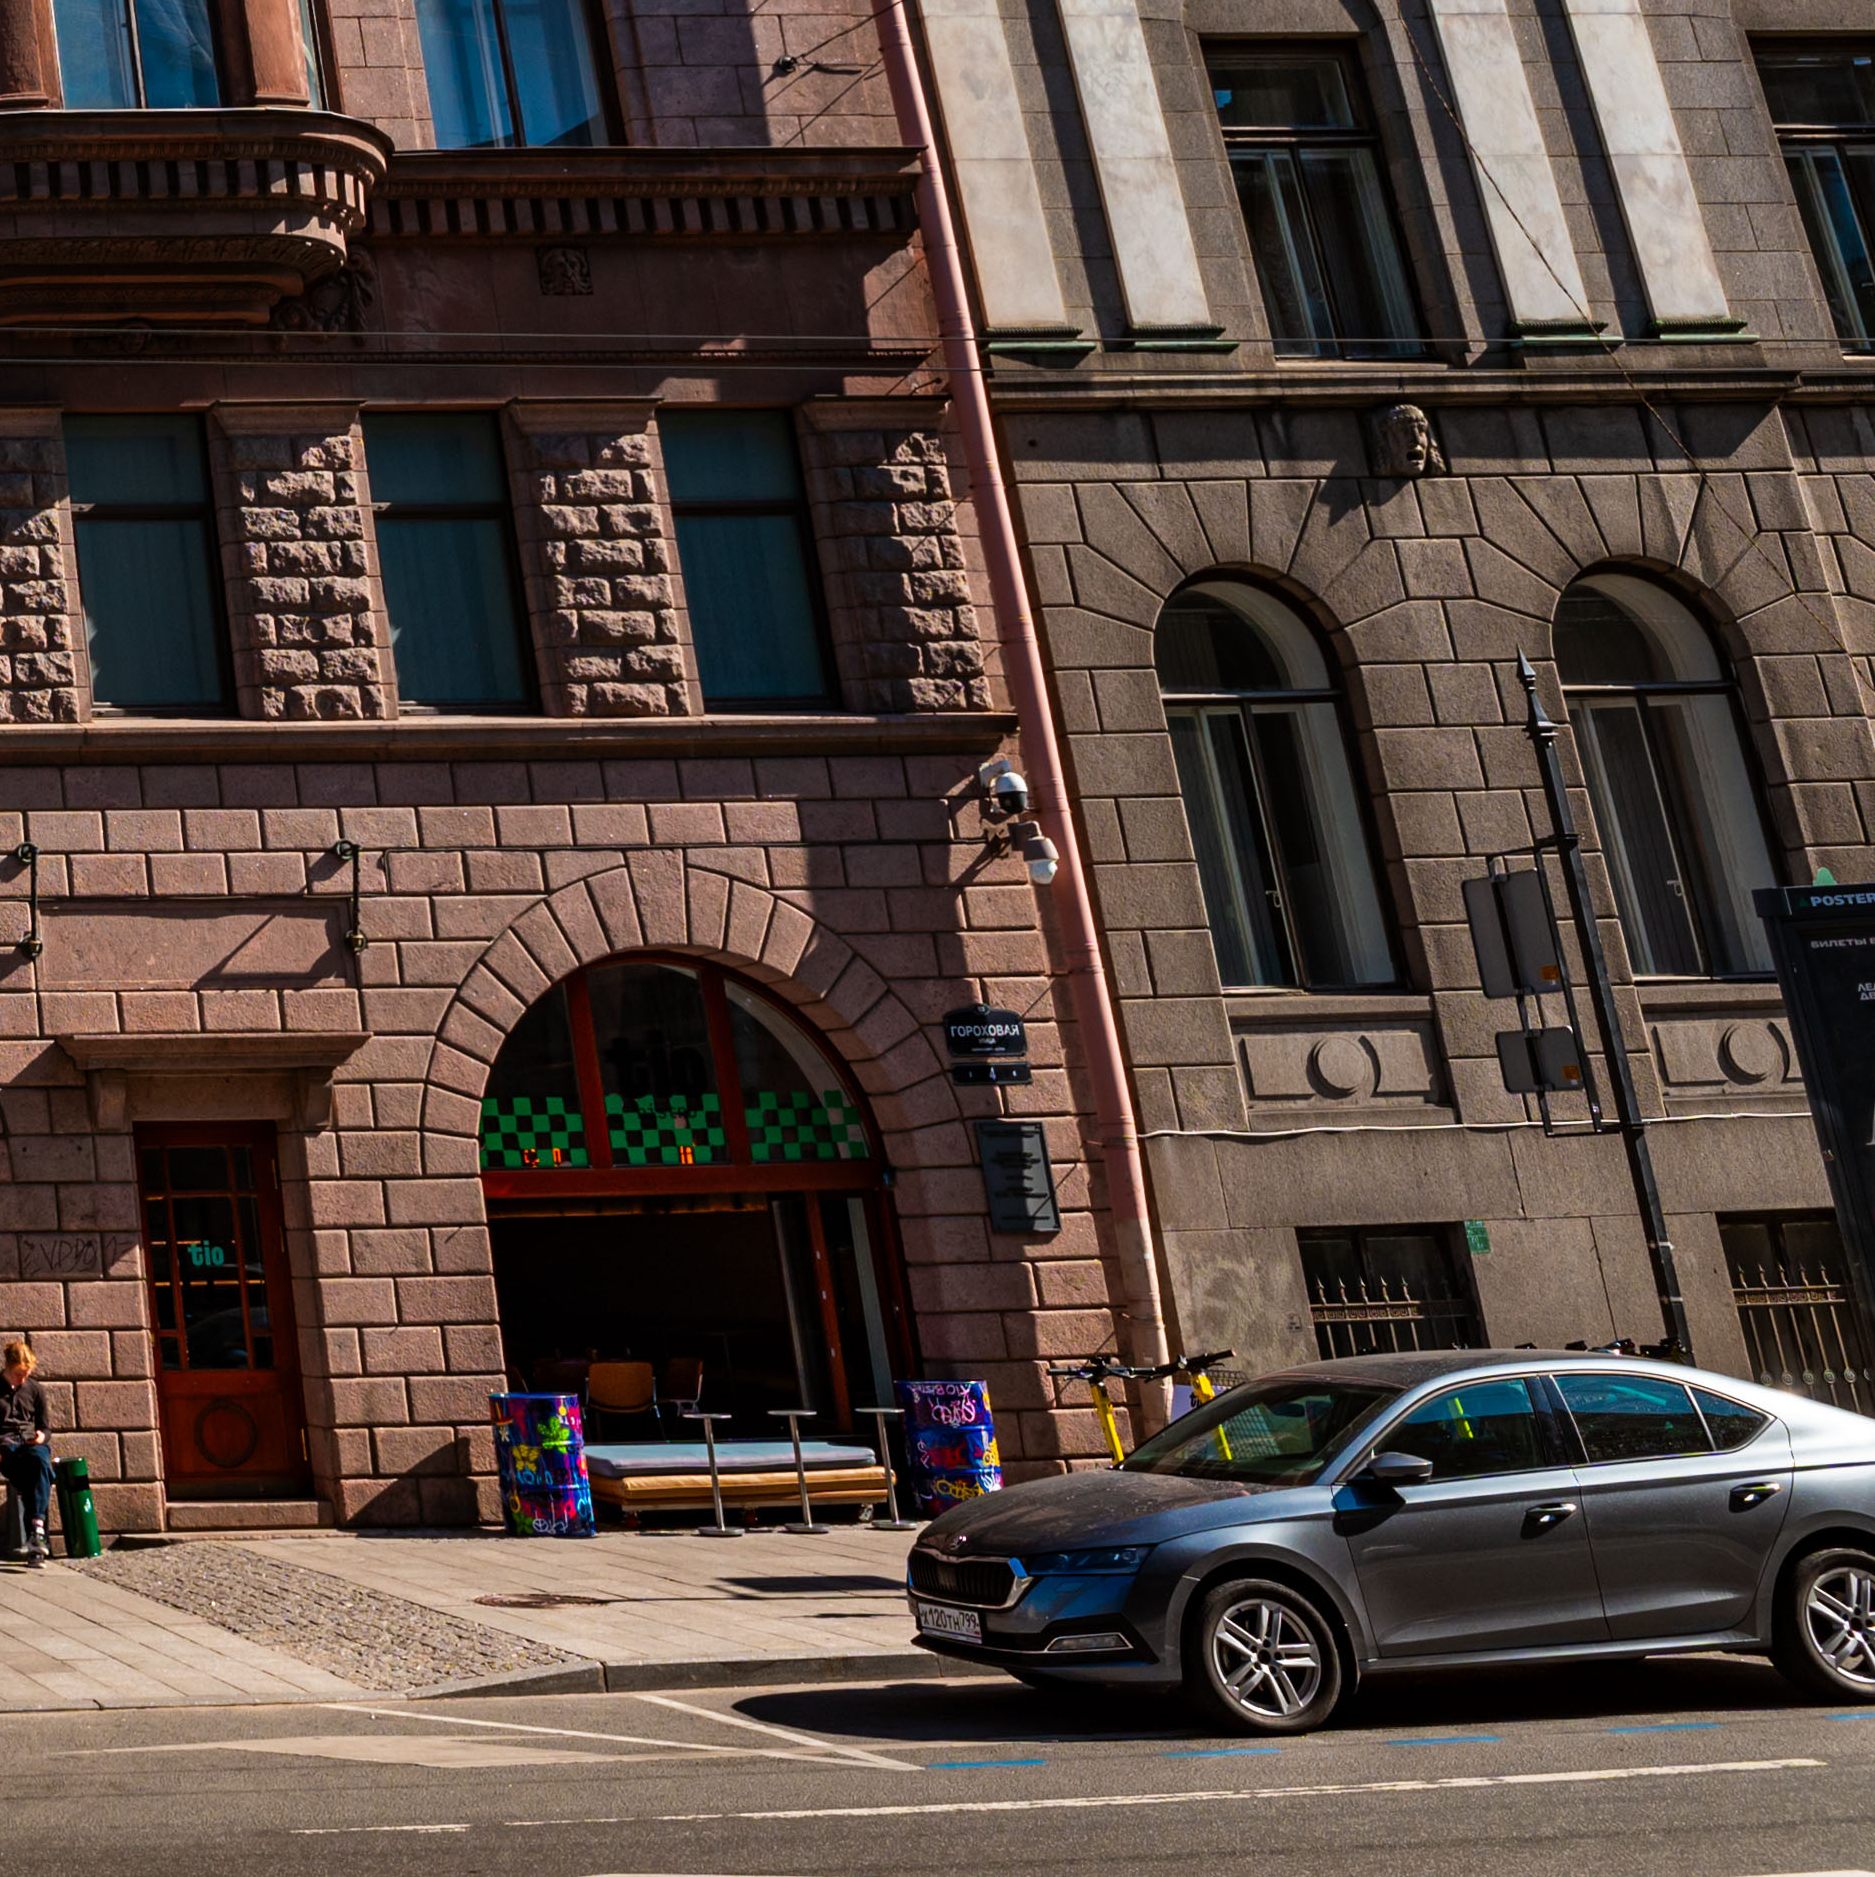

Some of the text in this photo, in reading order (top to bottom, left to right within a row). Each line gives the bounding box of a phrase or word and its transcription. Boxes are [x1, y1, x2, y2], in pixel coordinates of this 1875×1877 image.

[1811, 938, 1867, 949] БИЛЕТЫ
[950, 1024, 1020, 1037] ГОРОХОВАЯ
[188, 1239, 225, 1266] tio
